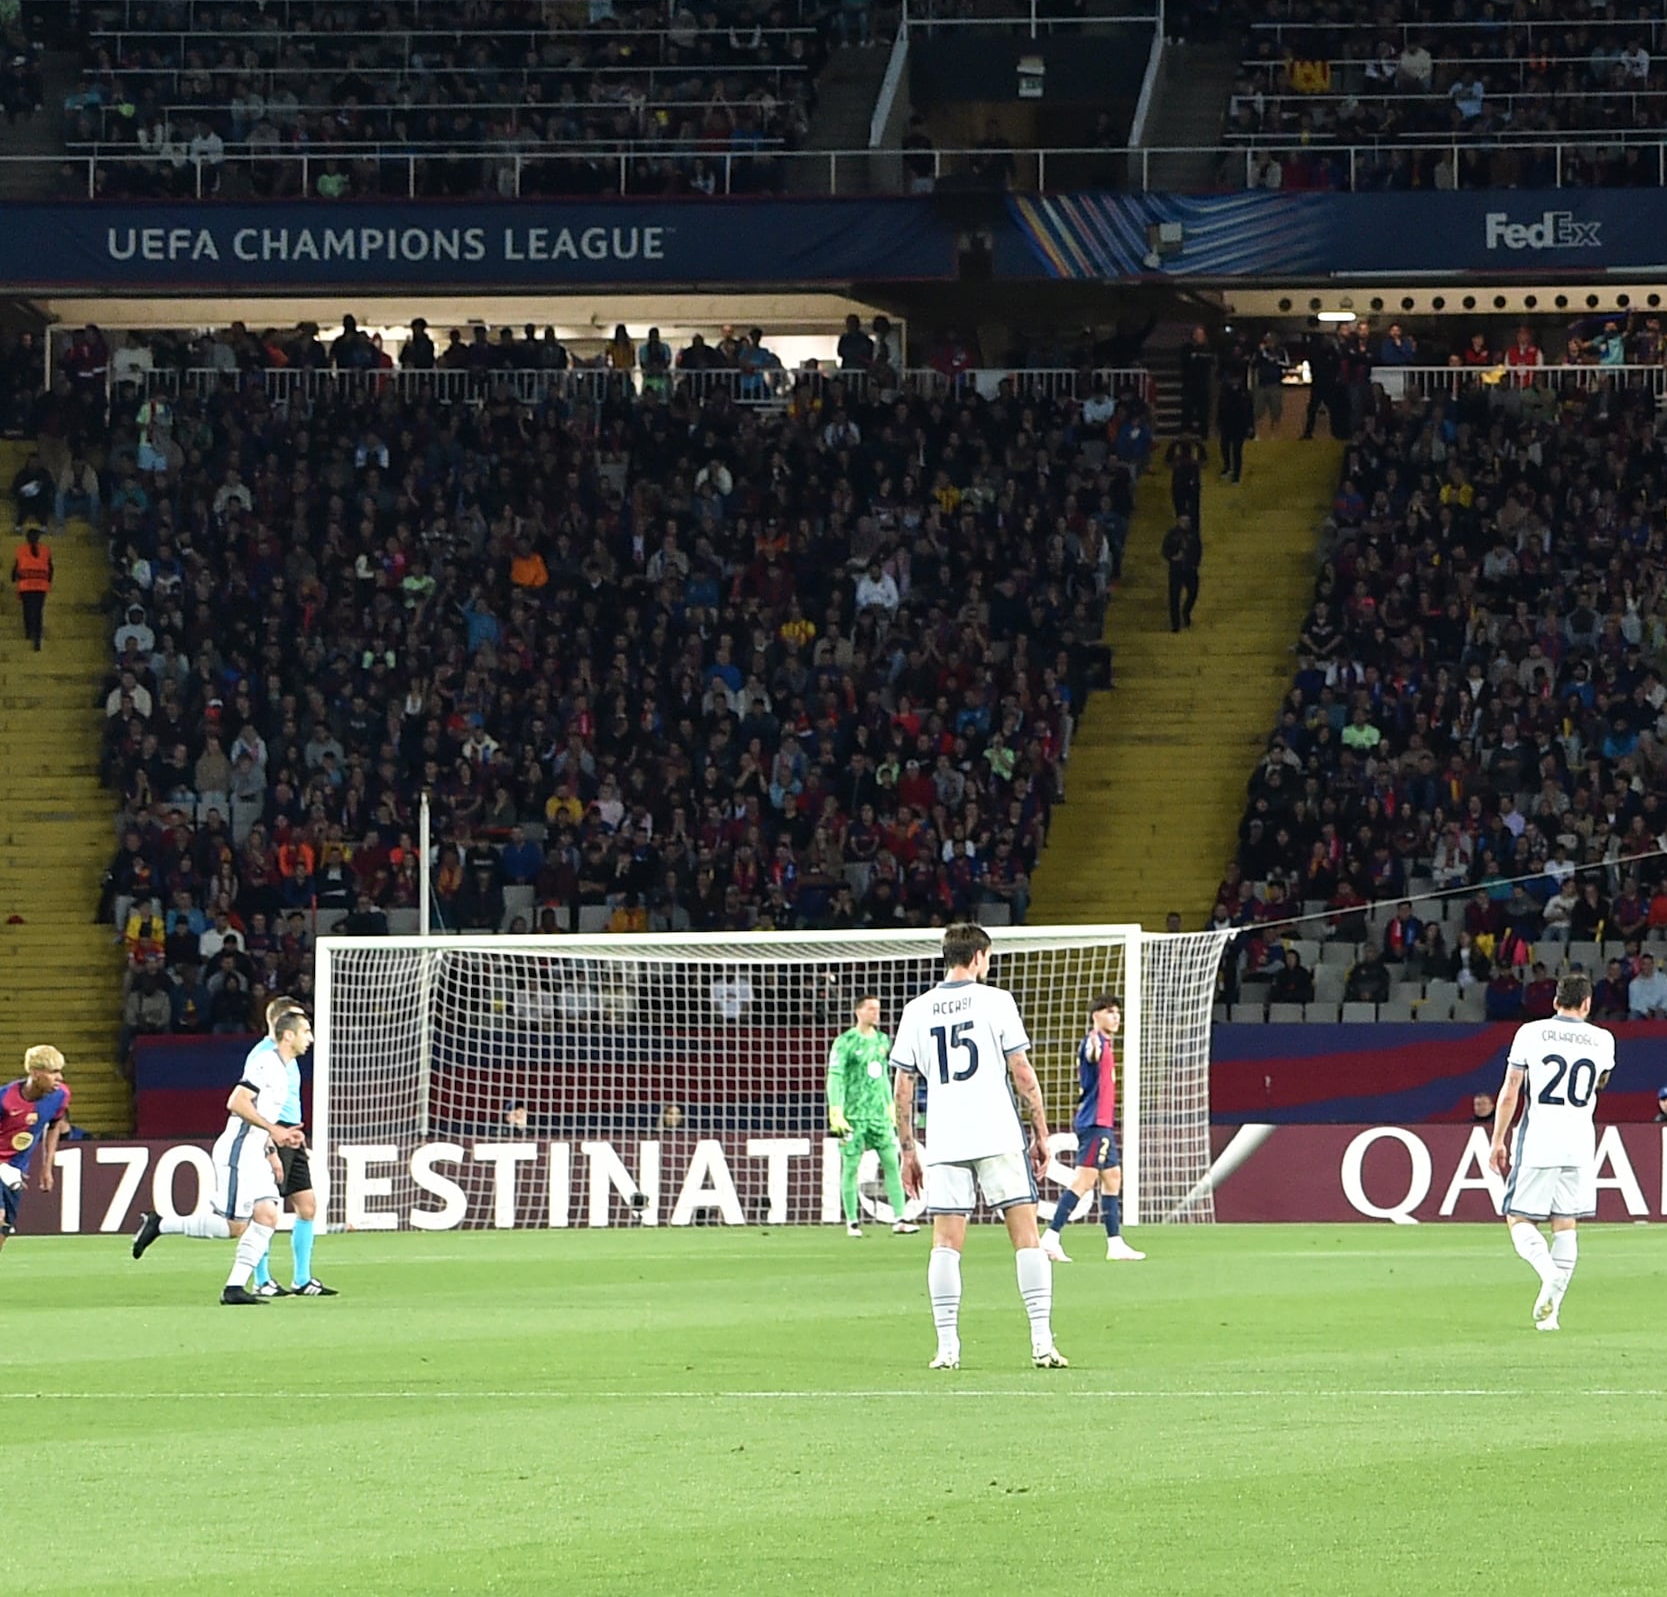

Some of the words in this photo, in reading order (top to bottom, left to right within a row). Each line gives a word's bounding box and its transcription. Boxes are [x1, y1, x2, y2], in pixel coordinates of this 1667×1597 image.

[107, 228, 220, 261] UEFA
[232, 227, 486, 260] CHAMPIONS
[1485, 210, 1602, 250] FedEx
[930, 1020, 979, 1084] 15
[1538, 1054, 1597, 1108] 20
[53, 1144, 218, 1232] 170
